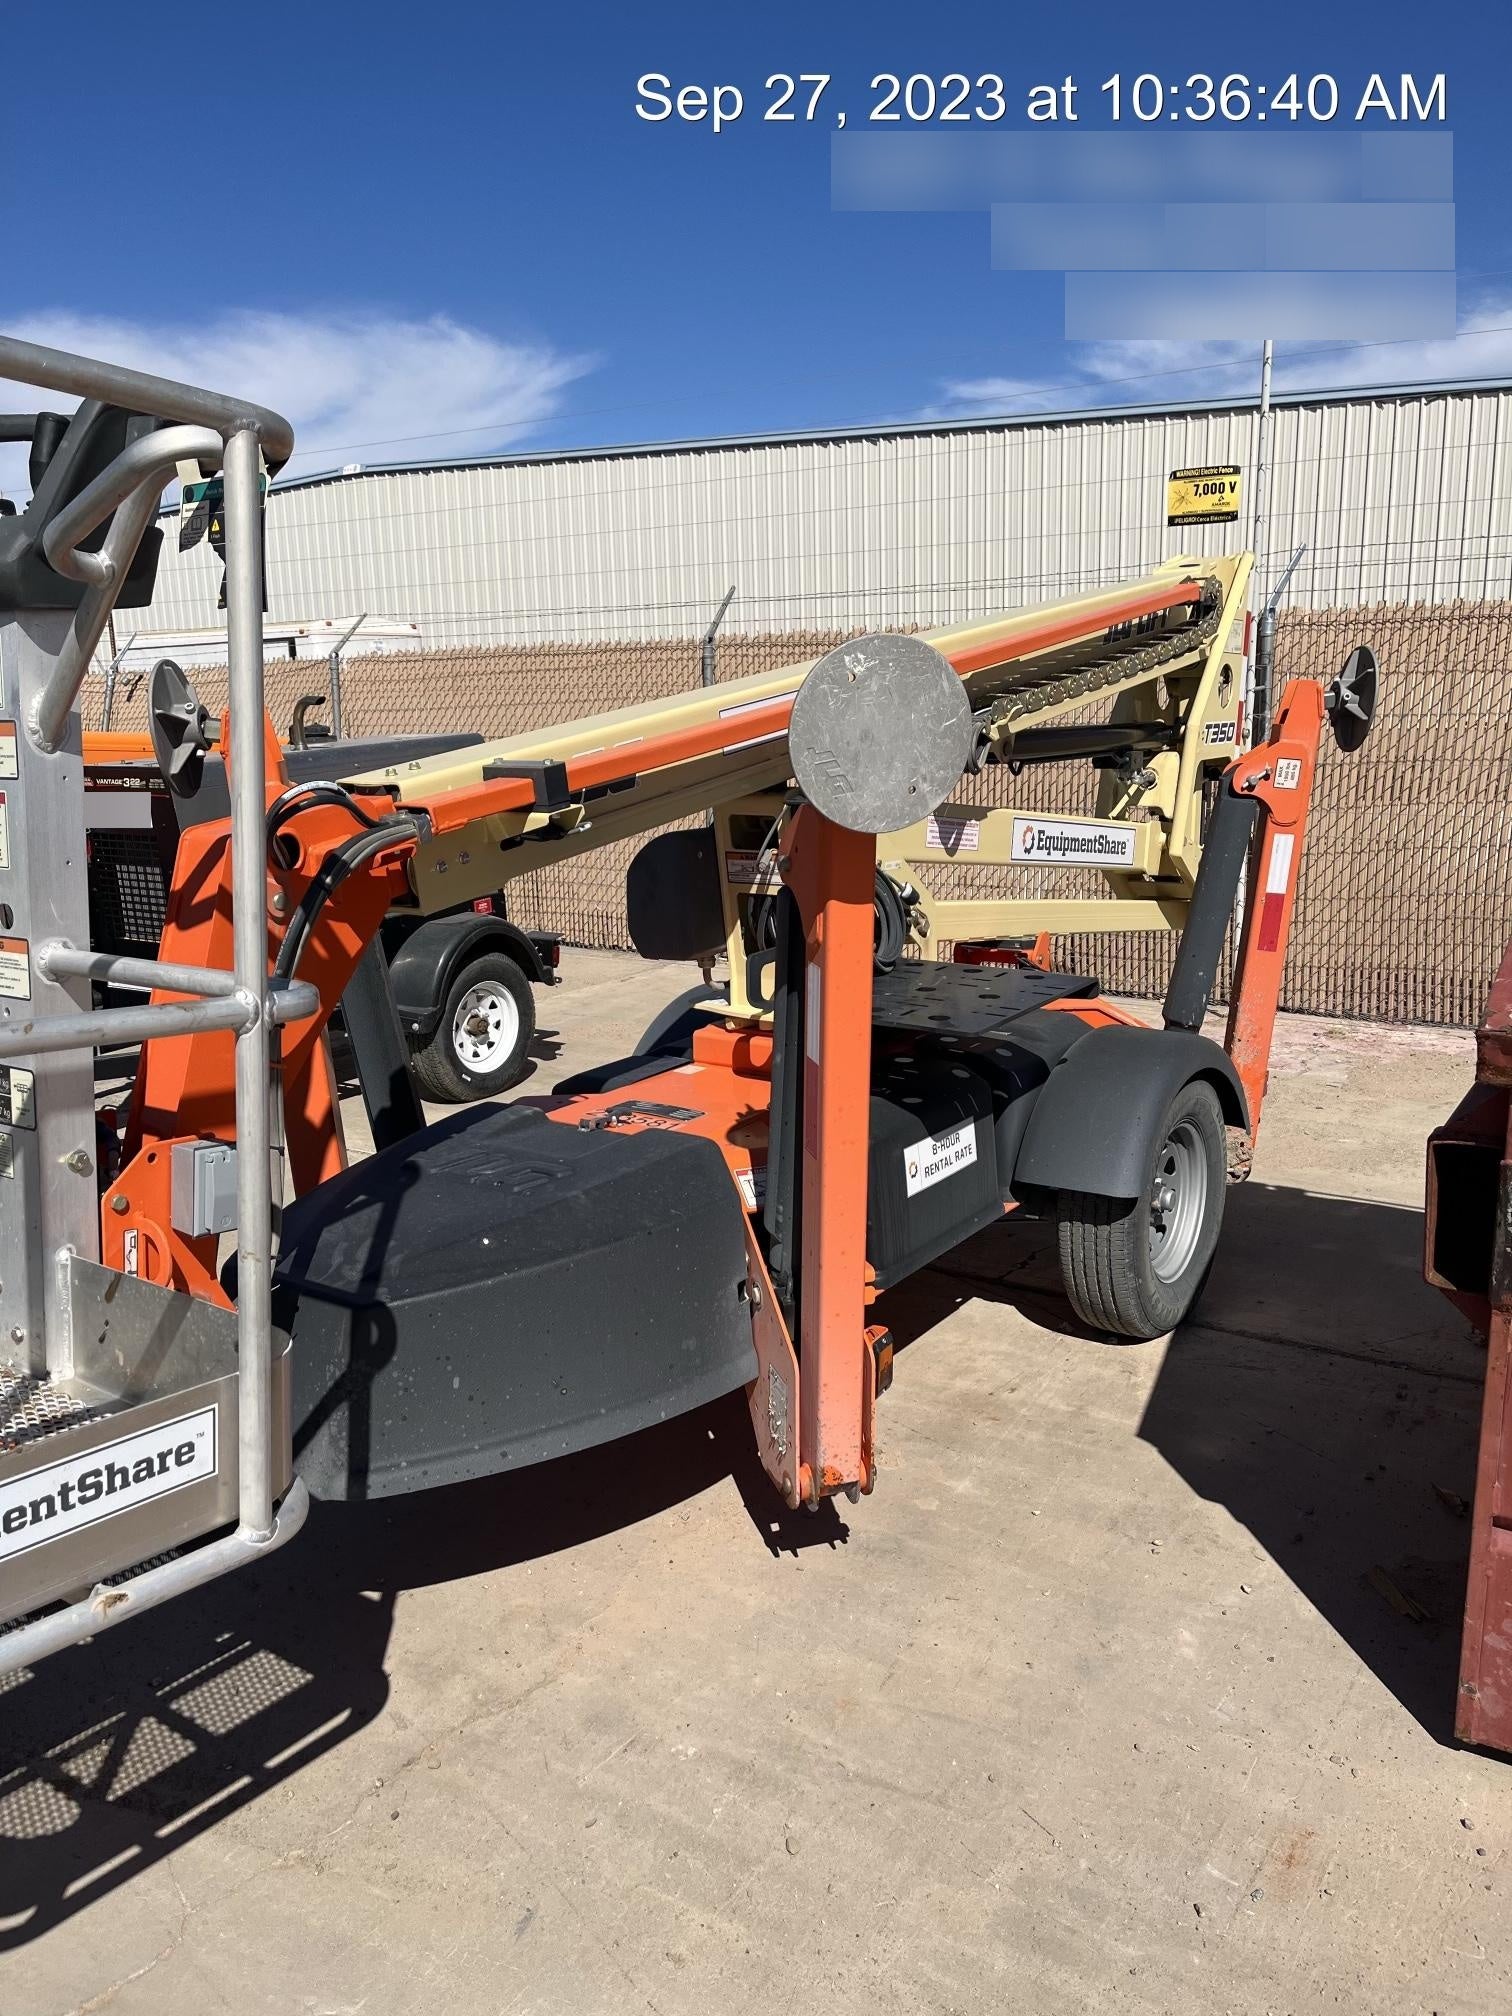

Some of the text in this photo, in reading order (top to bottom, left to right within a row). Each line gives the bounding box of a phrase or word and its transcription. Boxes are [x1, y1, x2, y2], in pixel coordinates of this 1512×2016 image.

[1201, 467, 1218, 475] Electric
[1219, 466, 1234, 474] Fence
[1193, 481, 1237, 498] 7,000 V
[1203, 721, 1236, 744] T350
[1036, 829, 1128, 857] EquipmentShare
[931, 1132, 961, 1155] 8-HOUR
[924, 1143, 973, 1178] RENTAL RATE
[0, 1440, 196, 1538] entShare
